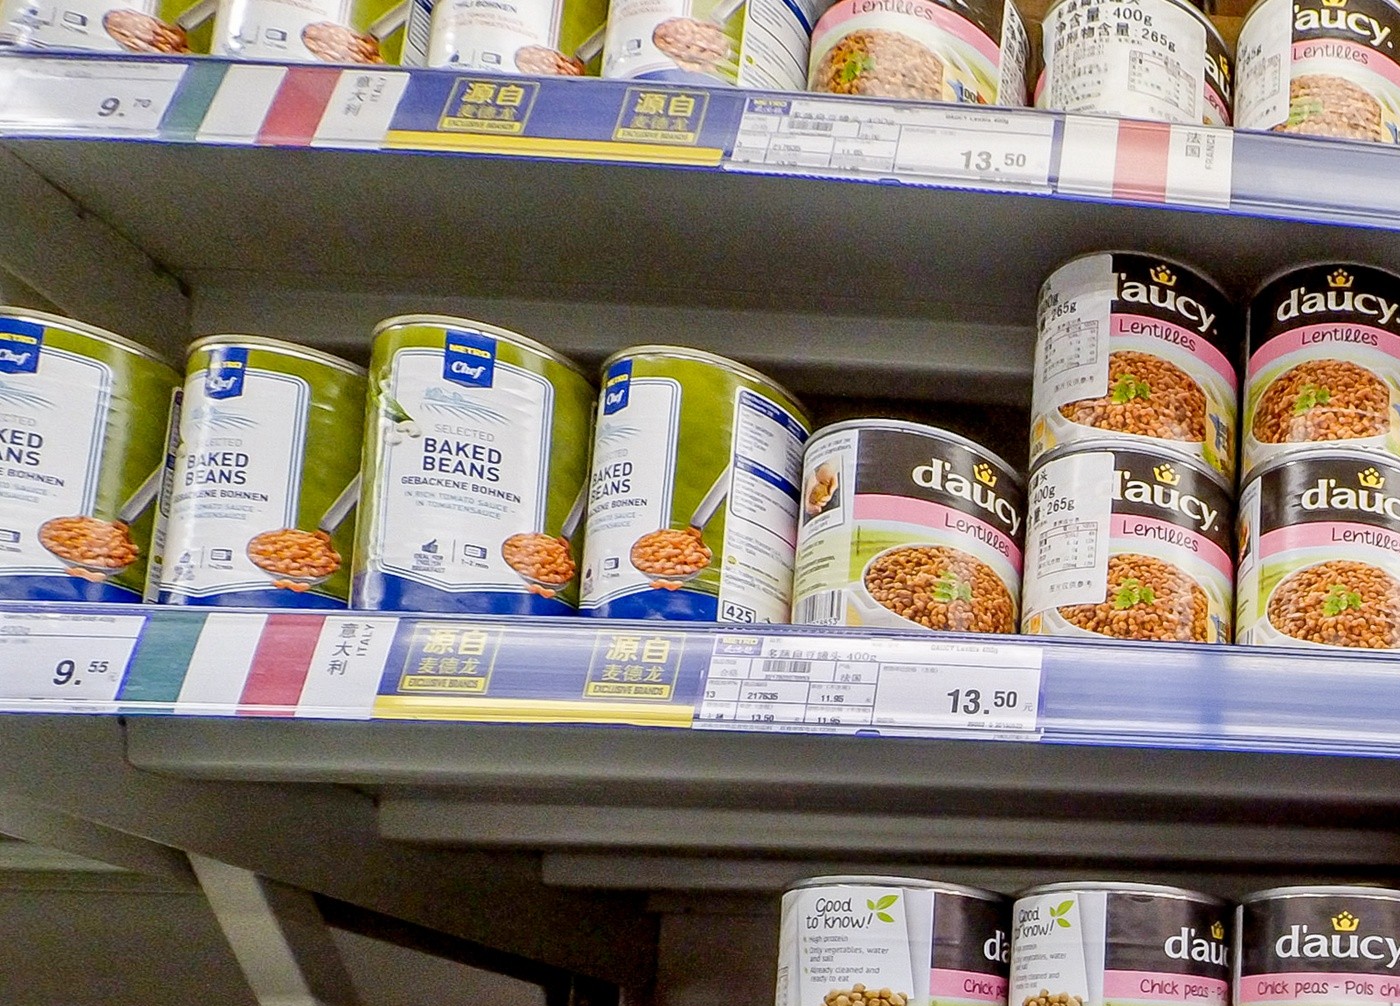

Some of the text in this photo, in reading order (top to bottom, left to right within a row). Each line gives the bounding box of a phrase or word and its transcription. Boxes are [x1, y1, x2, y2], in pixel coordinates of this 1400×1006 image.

[960, 148, 1026, 172] 13.50
[1118, 317, 1197, 352] Lentilles
[1301, 329, 1379, 347] Lentilles
[451, 360, 487, 379] Chef
[434, 423, 495, 442] SELECTED
[186, 451, 249, 470] BAKED
[424, 438, 502, 465] BAKED
[185, 468, 247, 486] BEANS
[422, 456, 500, 482] BEANS
[401, 476, 522, 504] GEBACKENE BOHNEN
[944, 512, 1012, 559] Lentilles
[1122, 519, 1199, 553] Lentilles
[725, 606, 752, 623] 425
[327, 622, 359, 676] 意大利
[357, 623, 374, 657] ITALY
[423, 629, 489, 656] 源自
[606, 635, 671, 663] 源自
[52, 659, 109, 687] 9.55
[417, 657, 481, 675] 麦德龙
[602, 664, 664, 683] 麦德龙
[947, 688, 1018, 715] 13.50
[816, 897, 853, 917] Good
[824, 913, 873, 929] know!
[1140, 978, 1209, 999] Chick peas
[1256, 980, 1289, 996] Chick
[1294, 982, 1329, 997] peas
